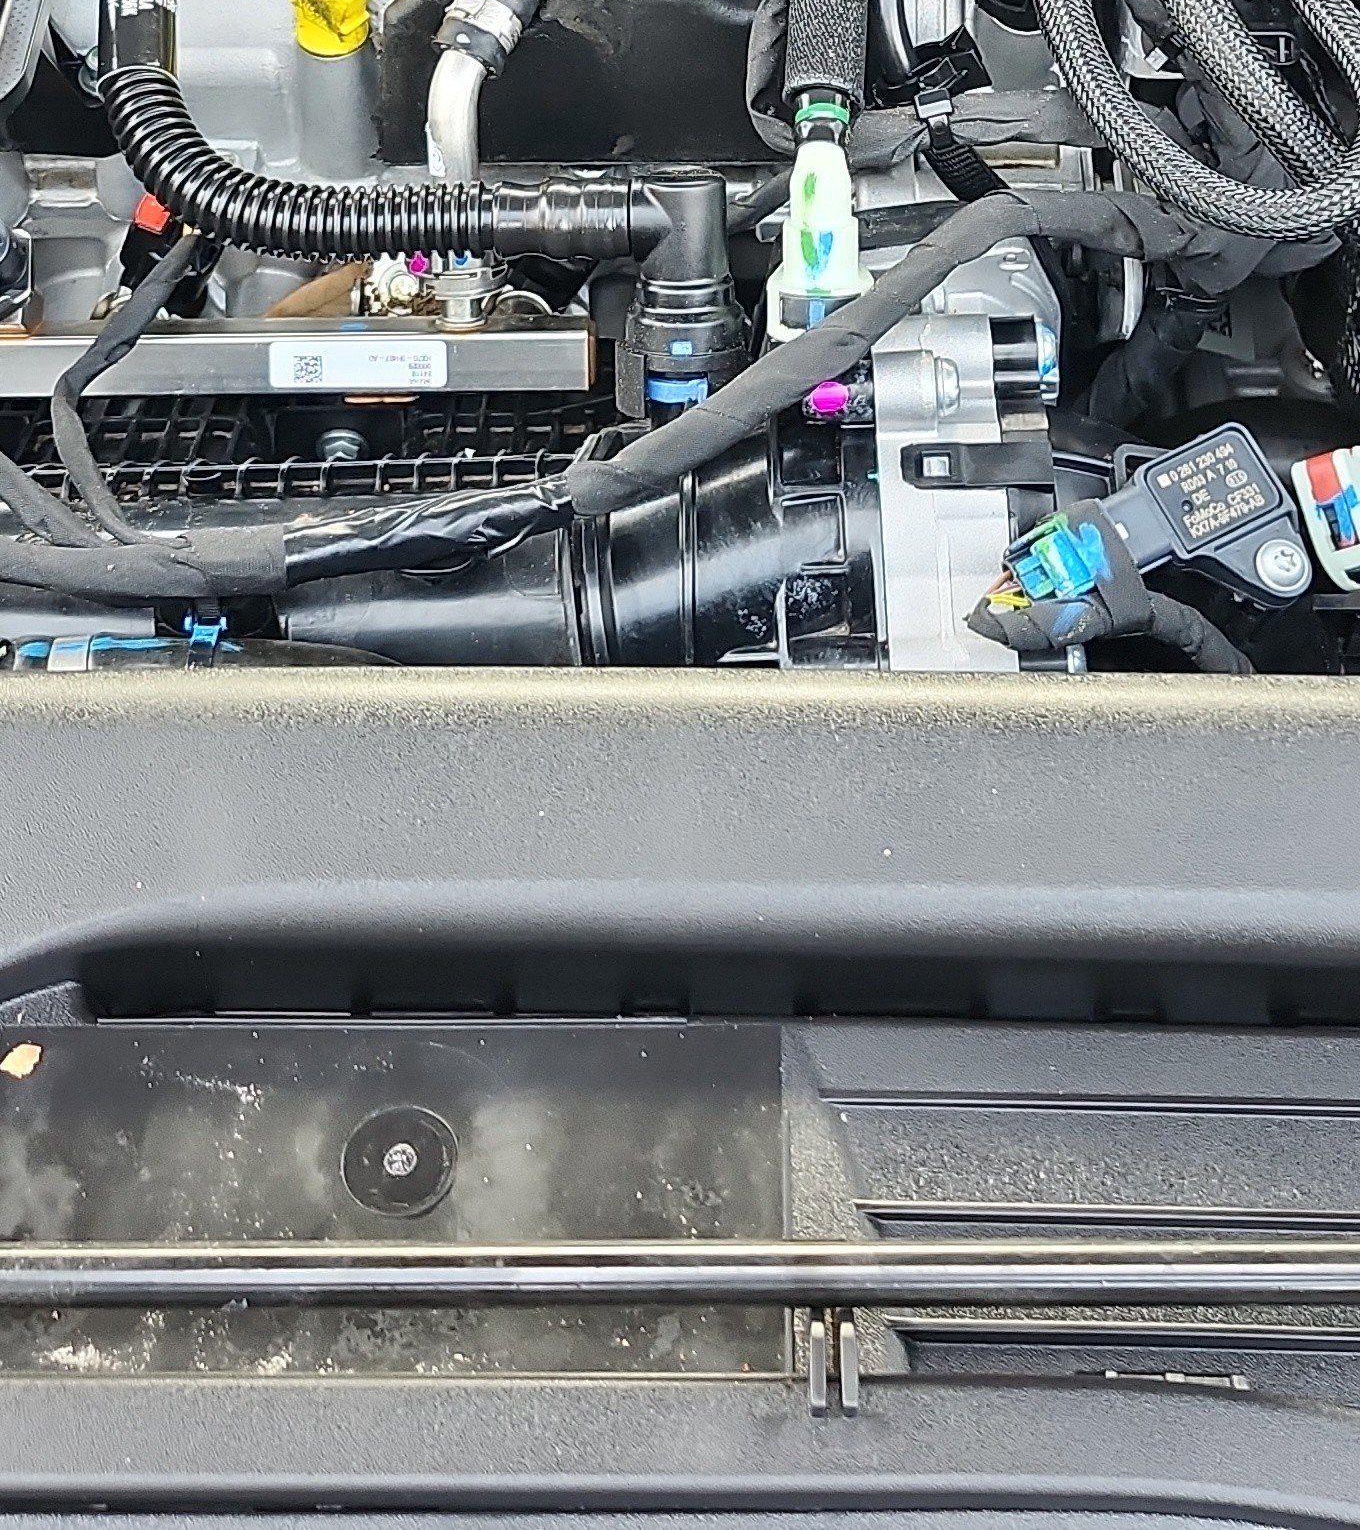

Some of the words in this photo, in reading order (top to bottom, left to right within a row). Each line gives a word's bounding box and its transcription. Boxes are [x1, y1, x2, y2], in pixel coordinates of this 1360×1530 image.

[1169, 470, 1179, 482] 0
[1196, 451, 1216, 469] 230
[1205, 469, 1217, 482] A
[1216, 463, 1225, 476] 7
[1191, 488, 1211, 506] DE
[1182, 502, 1226, 528] FoMoCo
